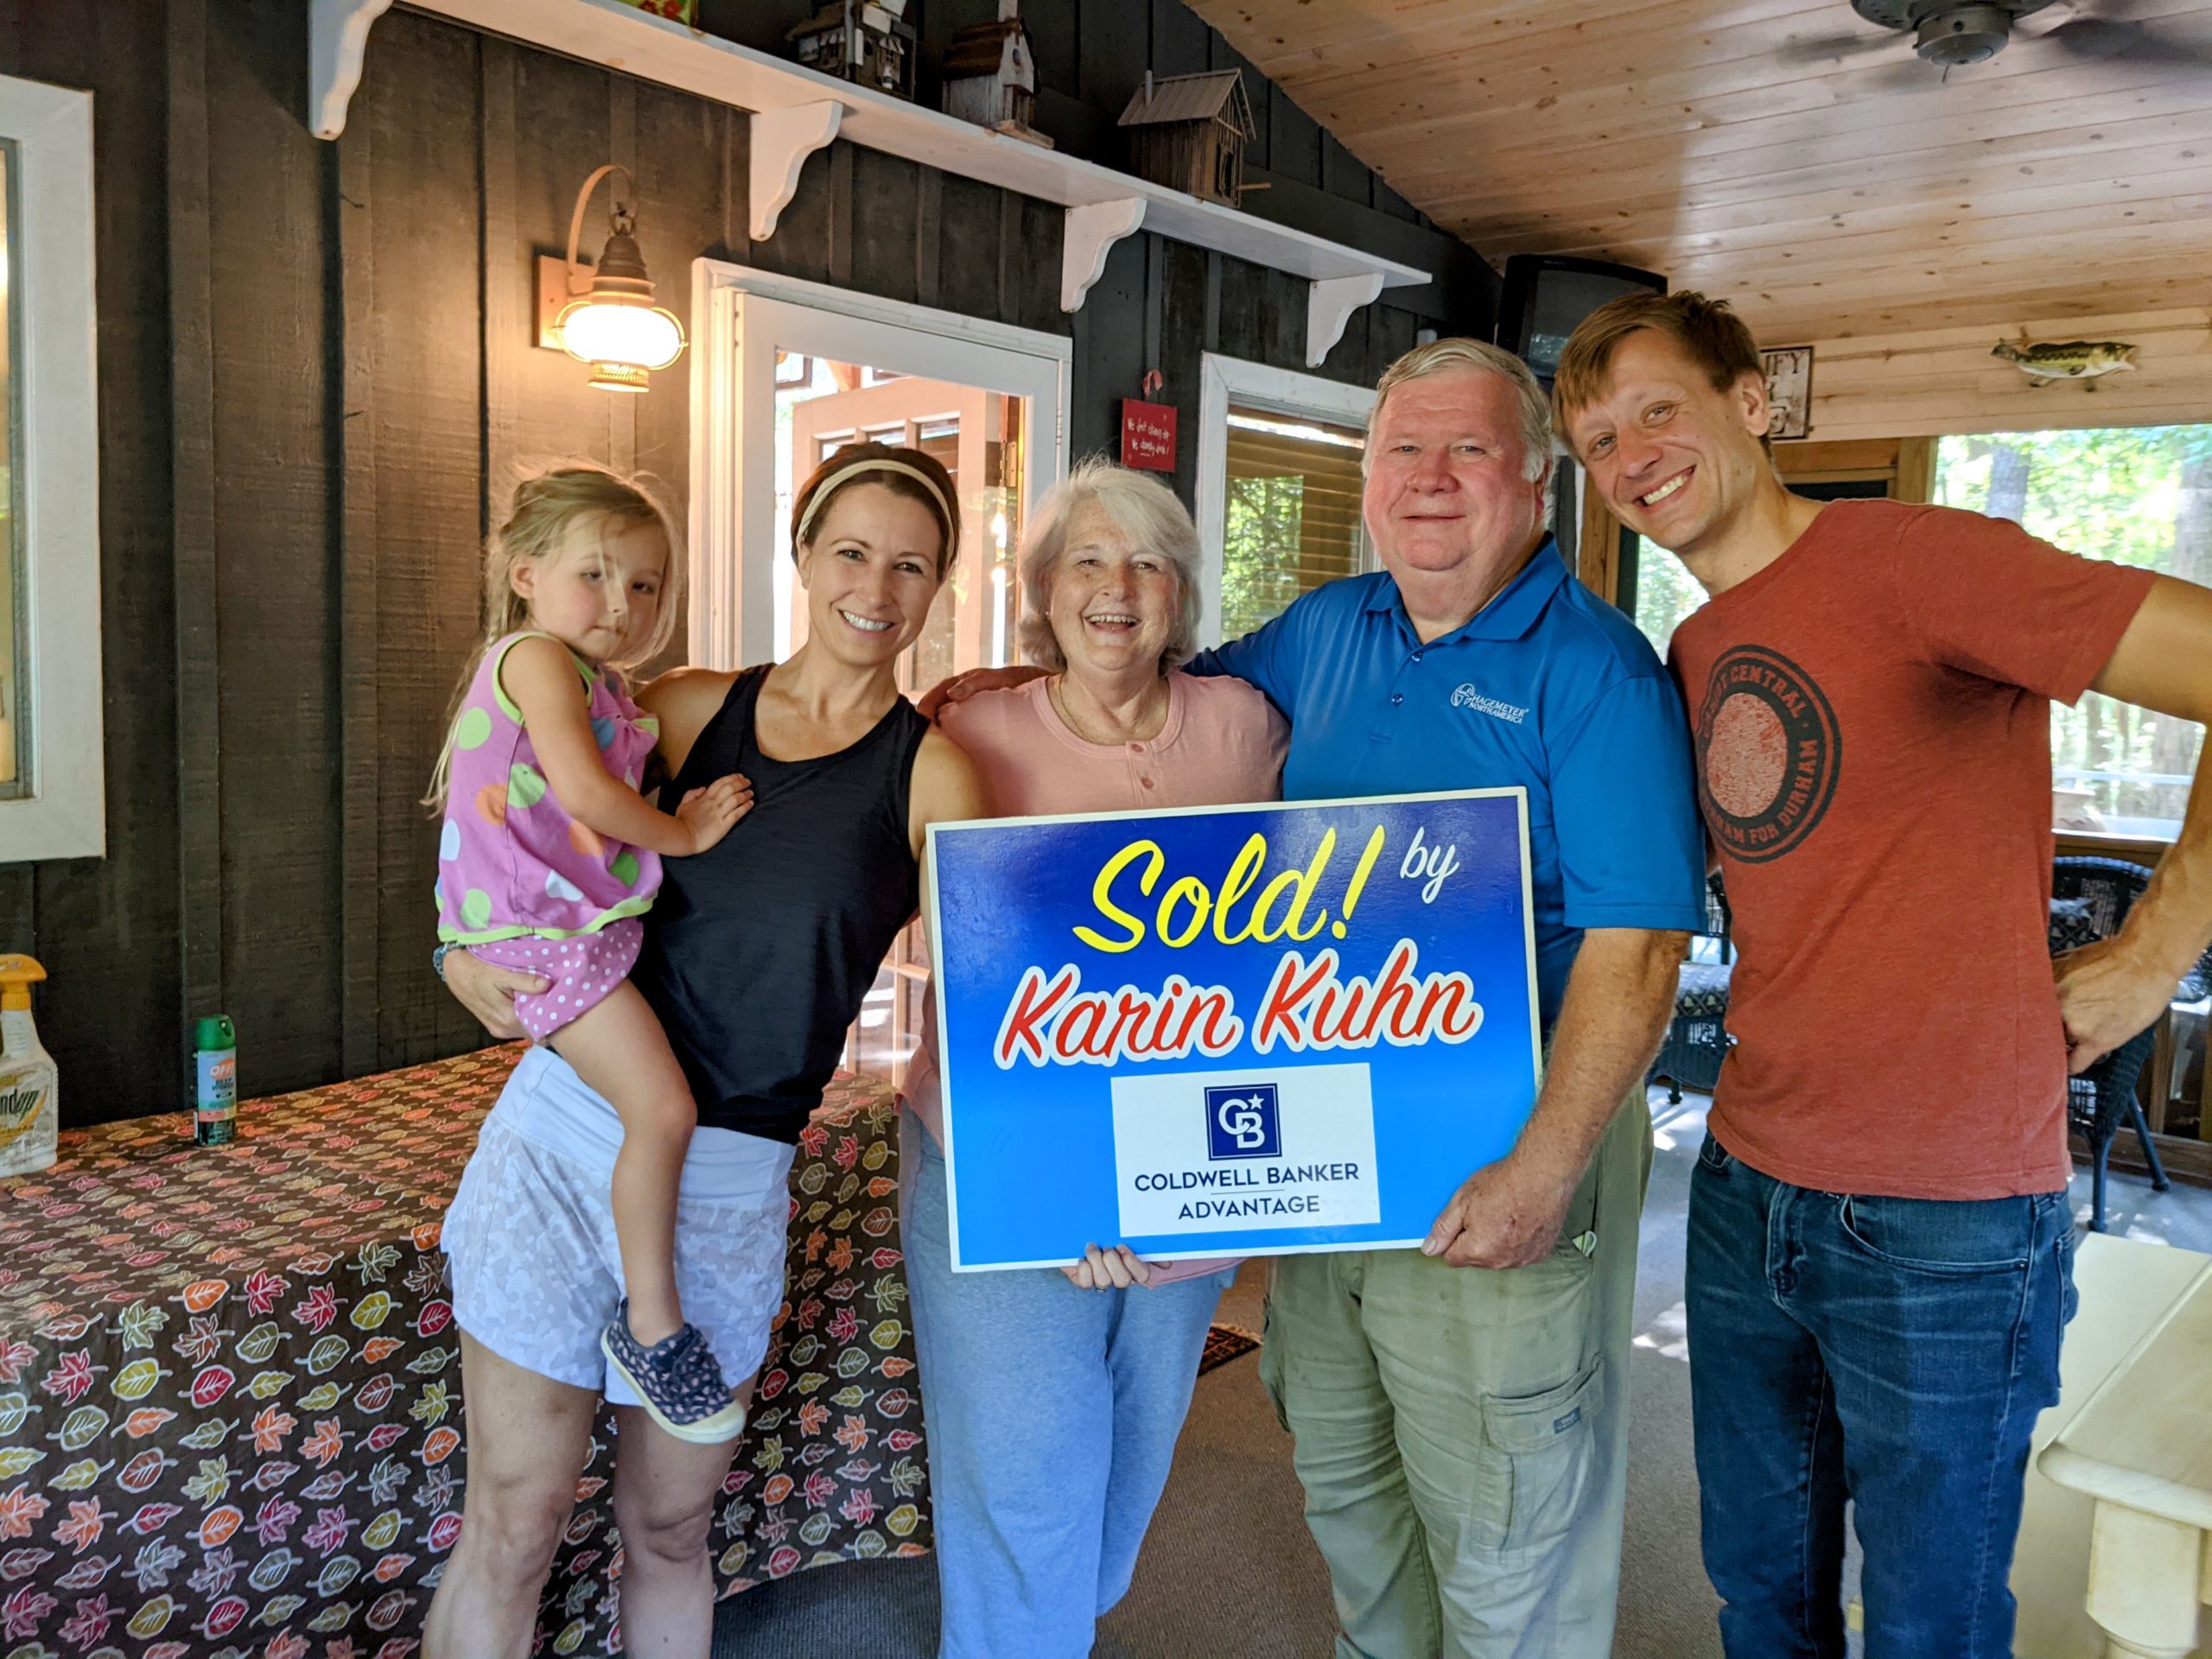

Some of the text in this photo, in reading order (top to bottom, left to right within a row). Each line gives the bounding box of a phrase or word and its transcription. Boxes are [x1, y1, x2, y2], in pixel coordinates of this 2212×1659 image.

[1471, 694, 1525, 718] HAGEMEYER
[1730, 664, 1807, 719] CENTRAL
[1468, 702, 1523, 725] NORTH AMERICA
[1777, 739, 1819, 828] DURHAM
[1071, 824, 1459, 953] Sold! by
[995, 938, 1484, 1070] Karin Kuhn
[1135, 1162, 1360, 1192] COLDWELL BANKER
[1178, 1195, 1320, 1220] ADVANTAGE
